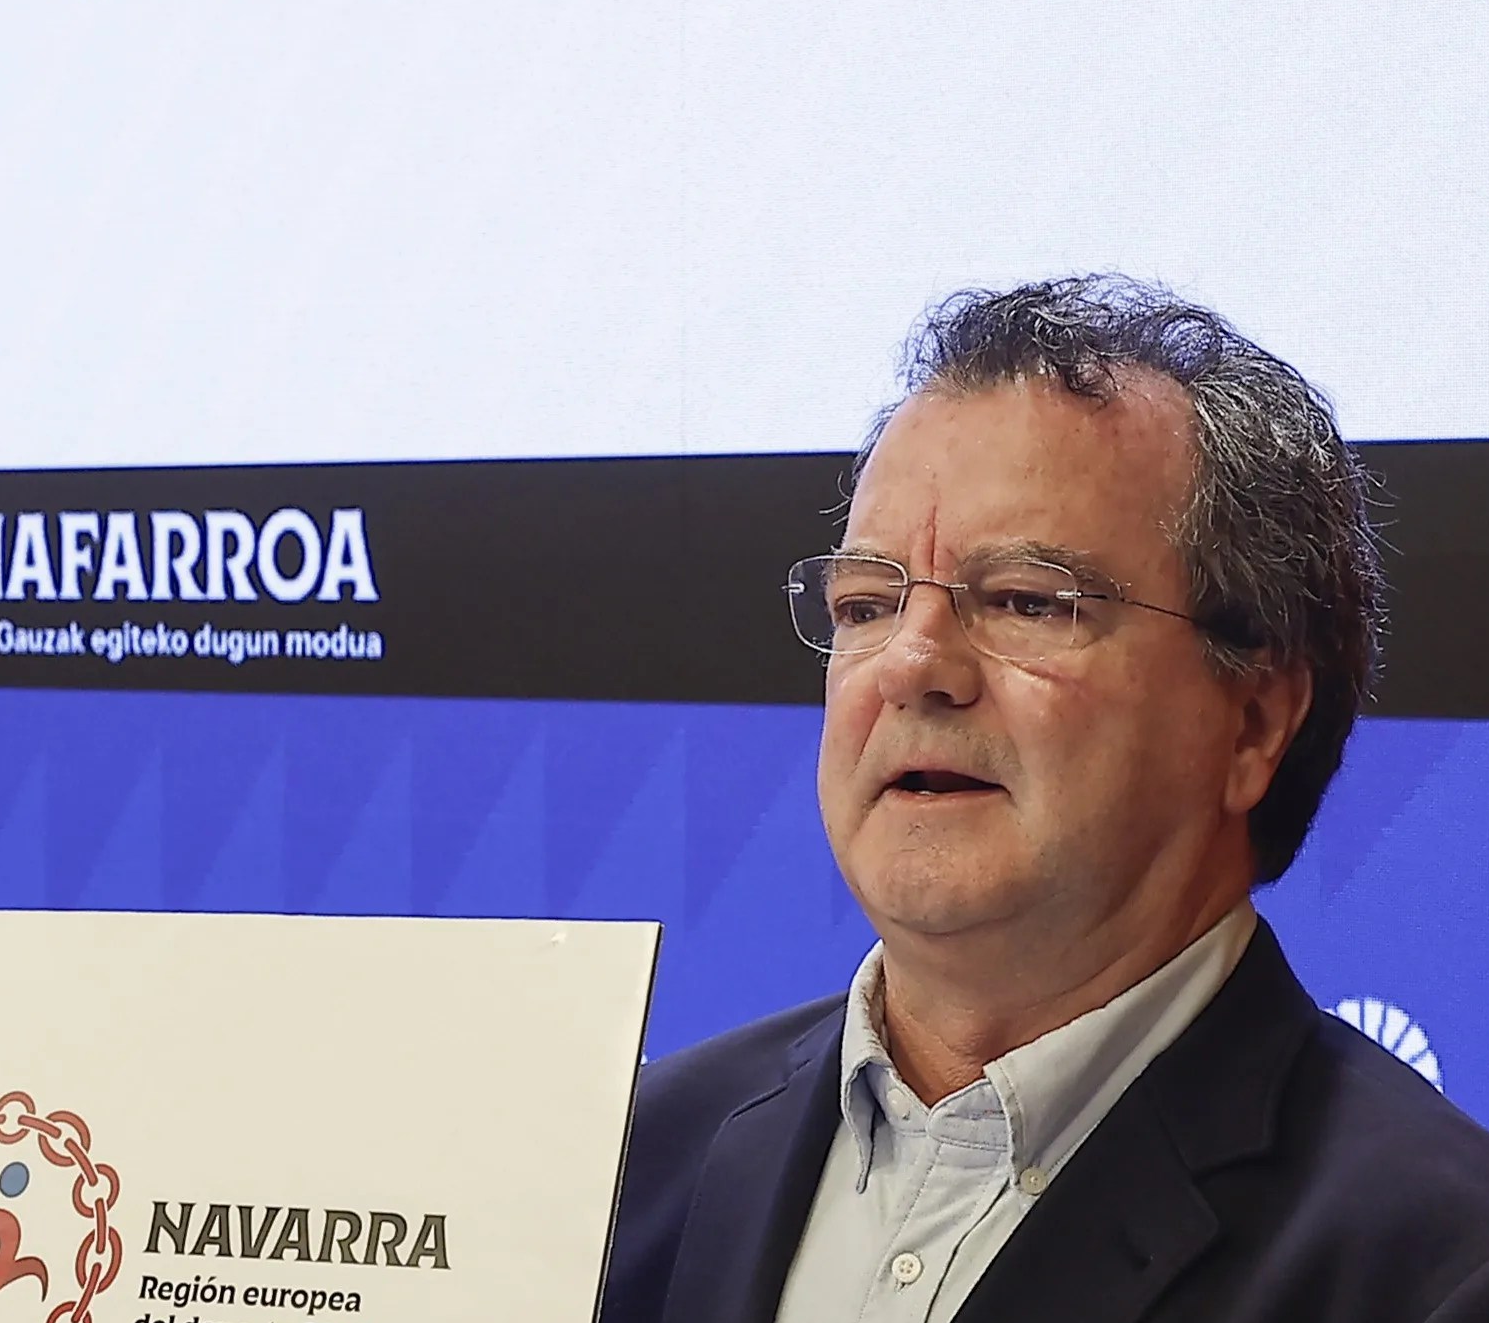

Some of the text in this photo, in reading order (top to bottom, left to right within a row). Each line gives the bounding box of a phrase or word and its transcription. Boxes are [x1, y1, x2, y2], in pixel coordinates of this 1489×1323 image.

[91, 623, 188, 660] egiteko
[194, 625, 278, 662] dugun
[286, 626, 381, 656] modua
[143, 1201, 450, 1269] NAVARRA
[139, 1275, 361, 1316] Región europea
